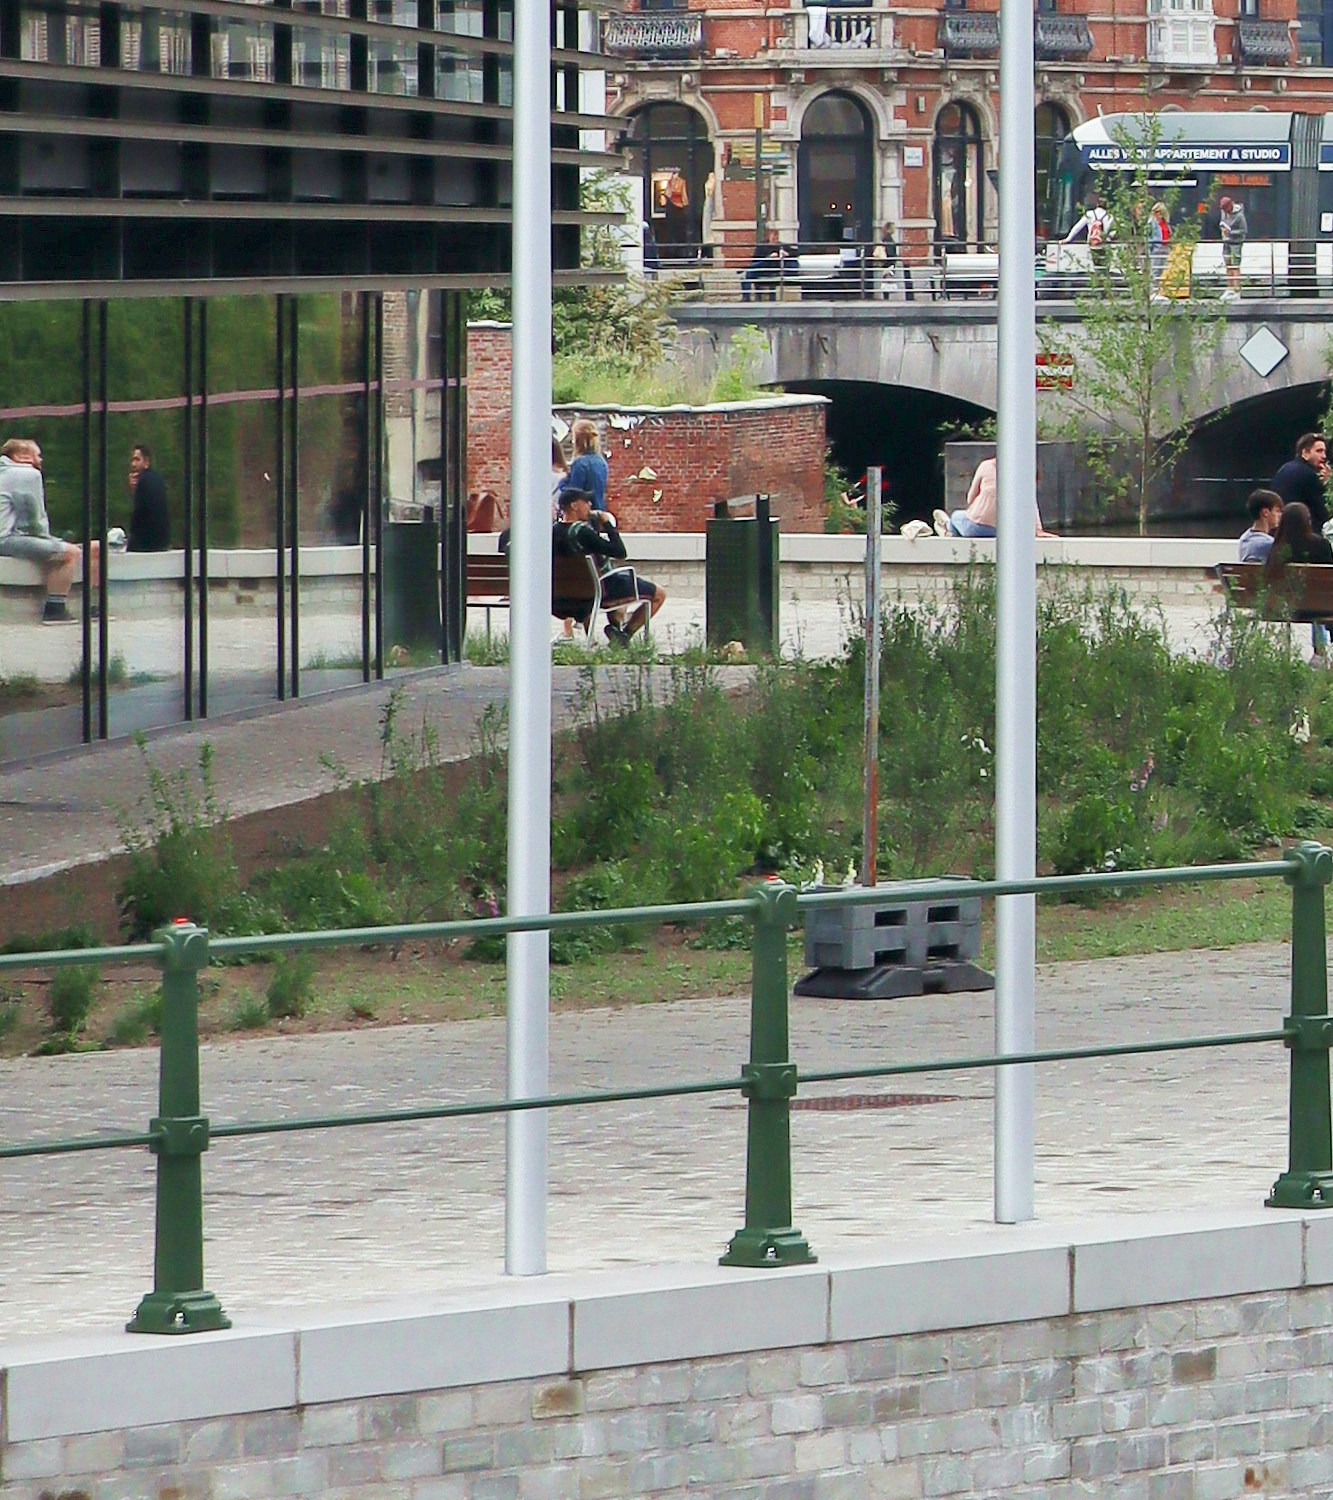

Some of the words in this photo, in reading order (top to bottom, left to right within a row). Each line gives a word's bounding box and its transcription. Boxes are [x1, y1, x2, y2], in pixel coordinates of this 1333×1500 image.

[1088, 148, 1120, 159] ALLES
[1153, 148, 1230, 159] APPARTEMENT
[1231, 148, 1240, 159] &
[1240, 148, 1281, 159] STUDIO
